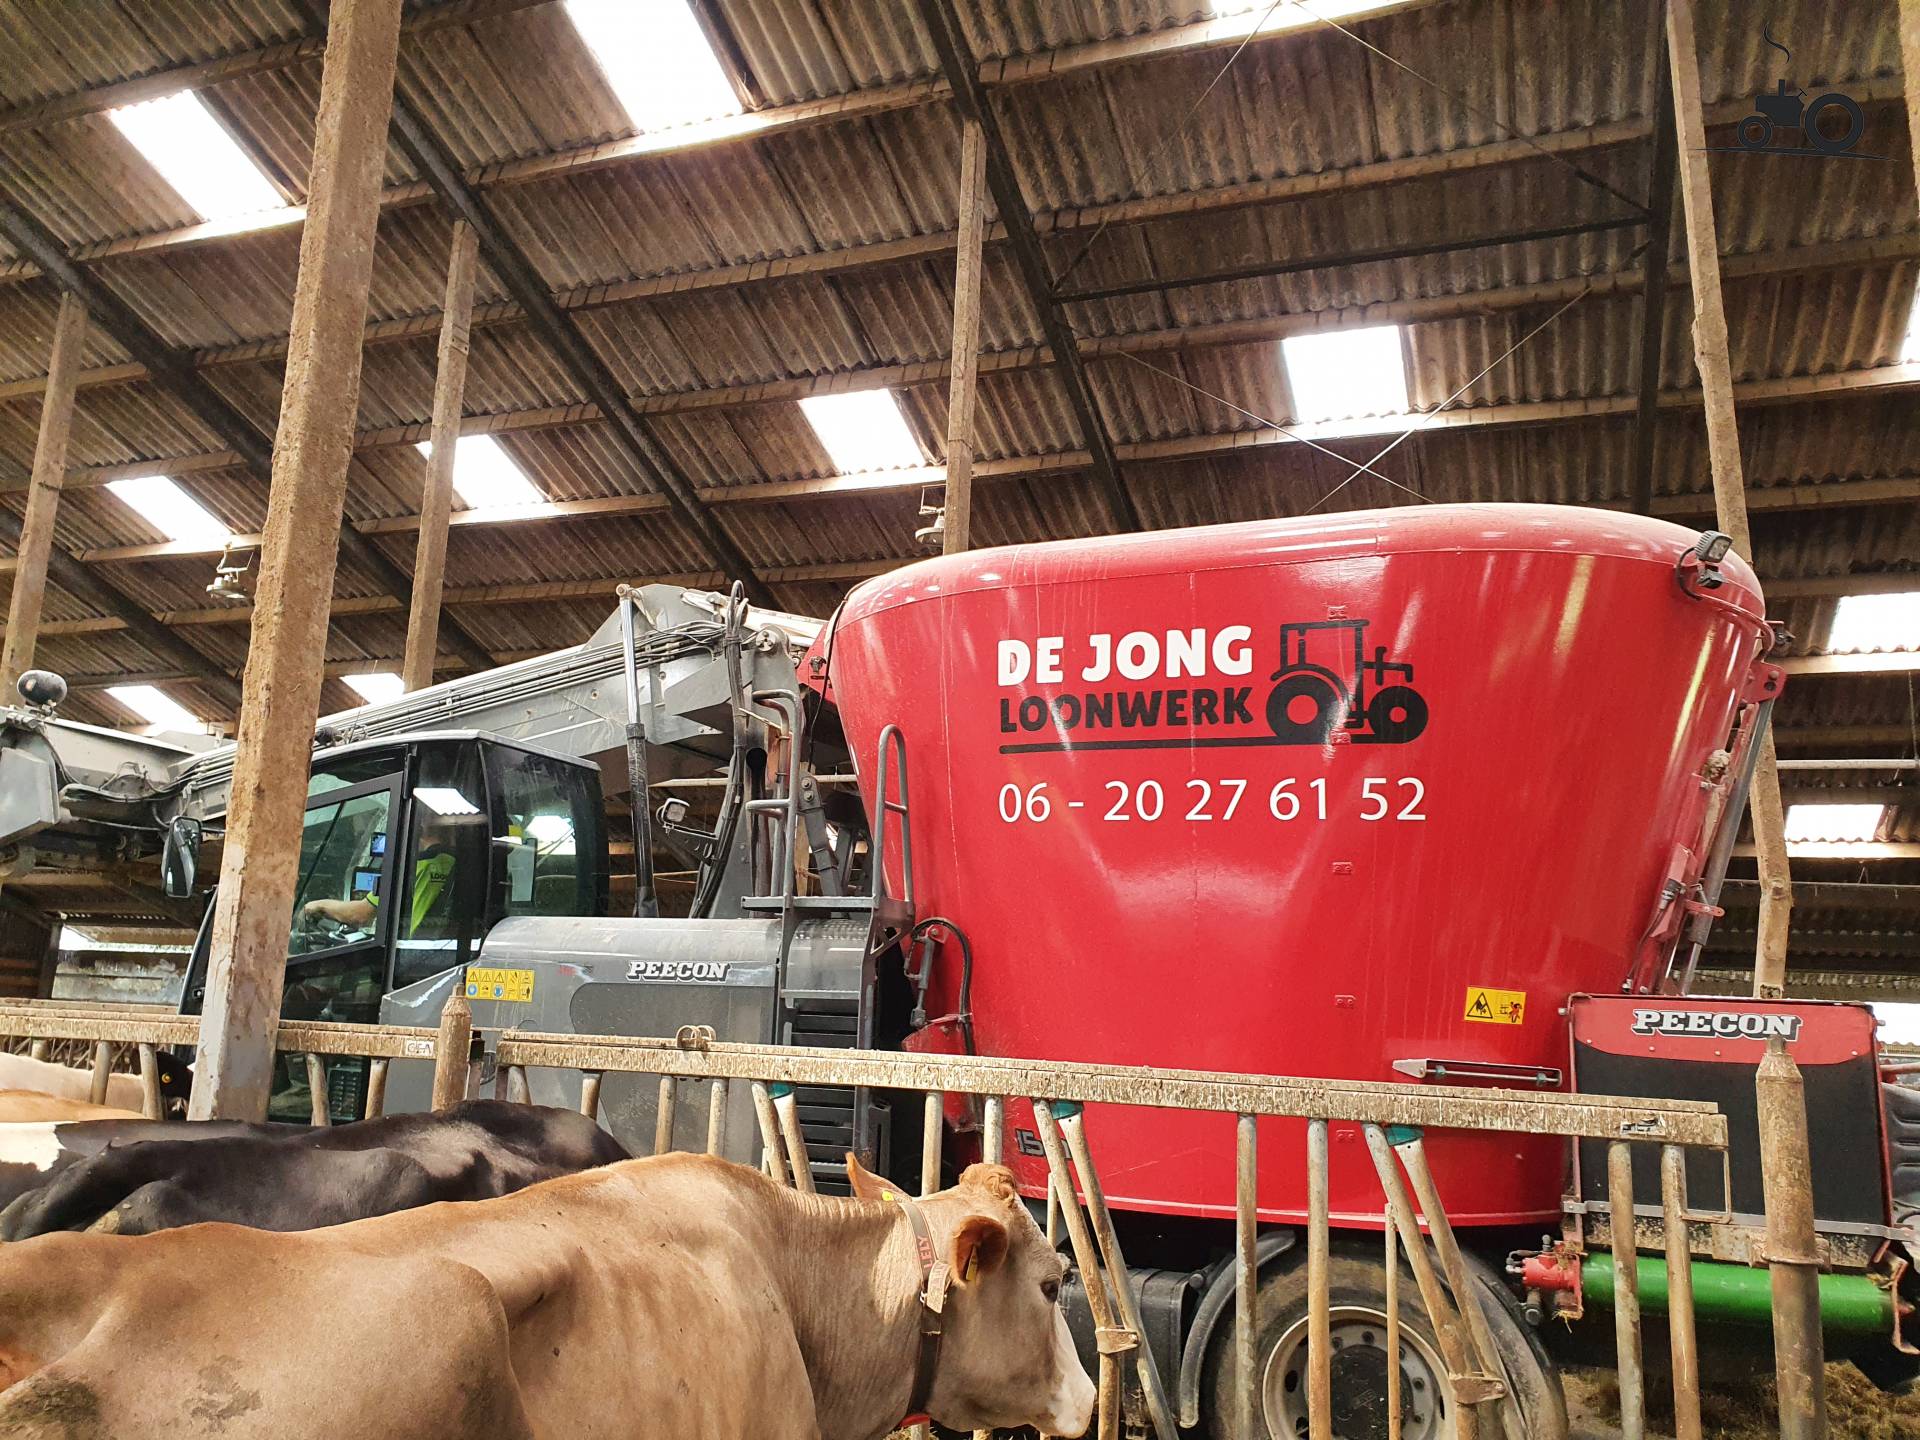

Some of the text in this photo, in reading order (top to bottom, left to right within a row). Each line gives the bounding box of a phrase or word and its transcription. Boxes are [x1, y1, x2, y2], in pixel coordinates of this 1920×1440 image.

[997, 625, 1252, 686] DE JONG
[1000, 687, 1254, 733] LOONWERK
[998, 782, 1051, 822] 06
[1104, 779, 1164, 821] 20
[1185, 779, 1248, 821] 27
[1269, 777, 1328, 820] 61
[1360, 776, 1426, 820] 52
[626, 961, 732, 983] PEECON
[1631, 1010, 1802, 1041] PEECON
[917, 1235, 933, 1269] LELY
